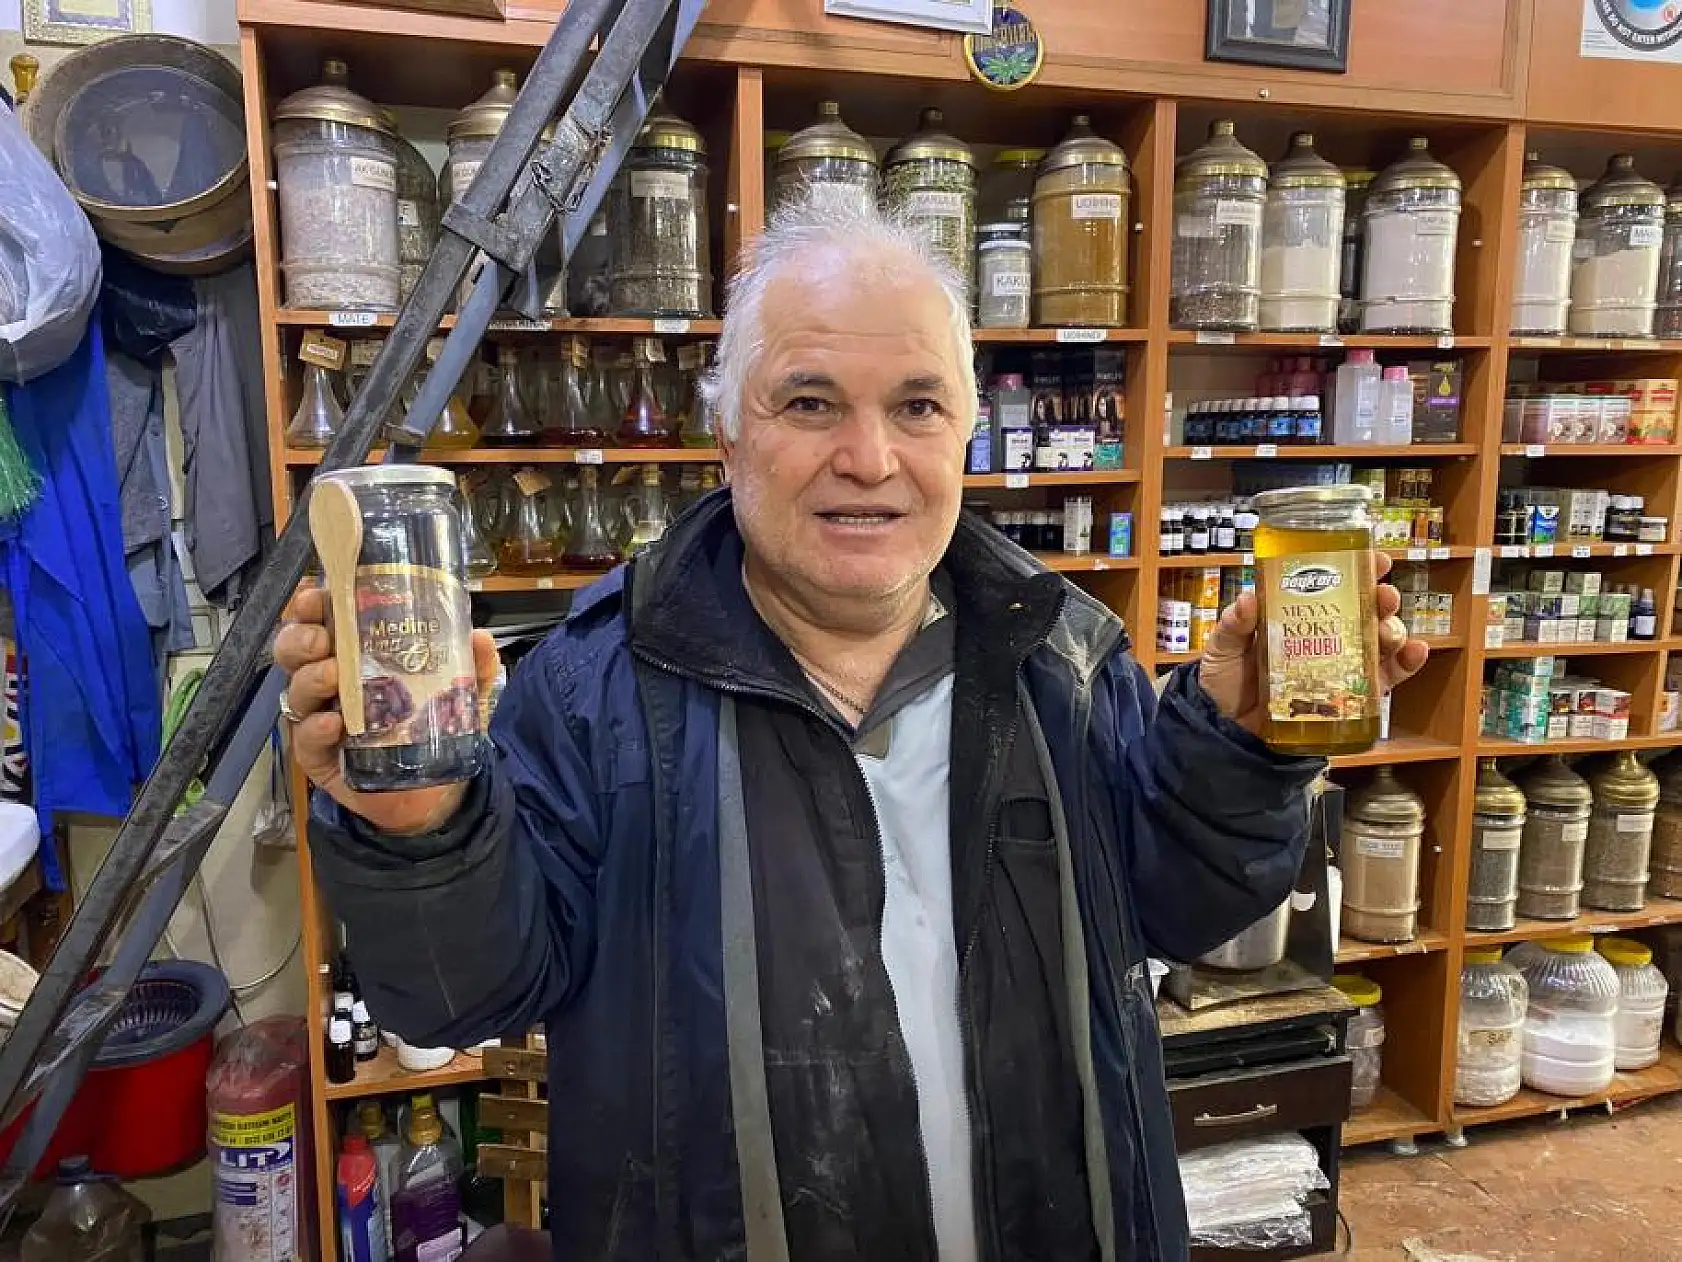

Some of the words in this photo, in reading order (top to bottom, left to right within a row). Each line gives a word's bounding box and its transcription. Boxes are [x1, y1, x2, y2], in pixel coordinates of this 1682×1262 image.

[338, 312, 369, 325] MATE
[1282, 602, 1341, 616] MEYAN
[369, 616, 440, 635] Medine
[1284, 635, 1342, 657] ŞURUBU
